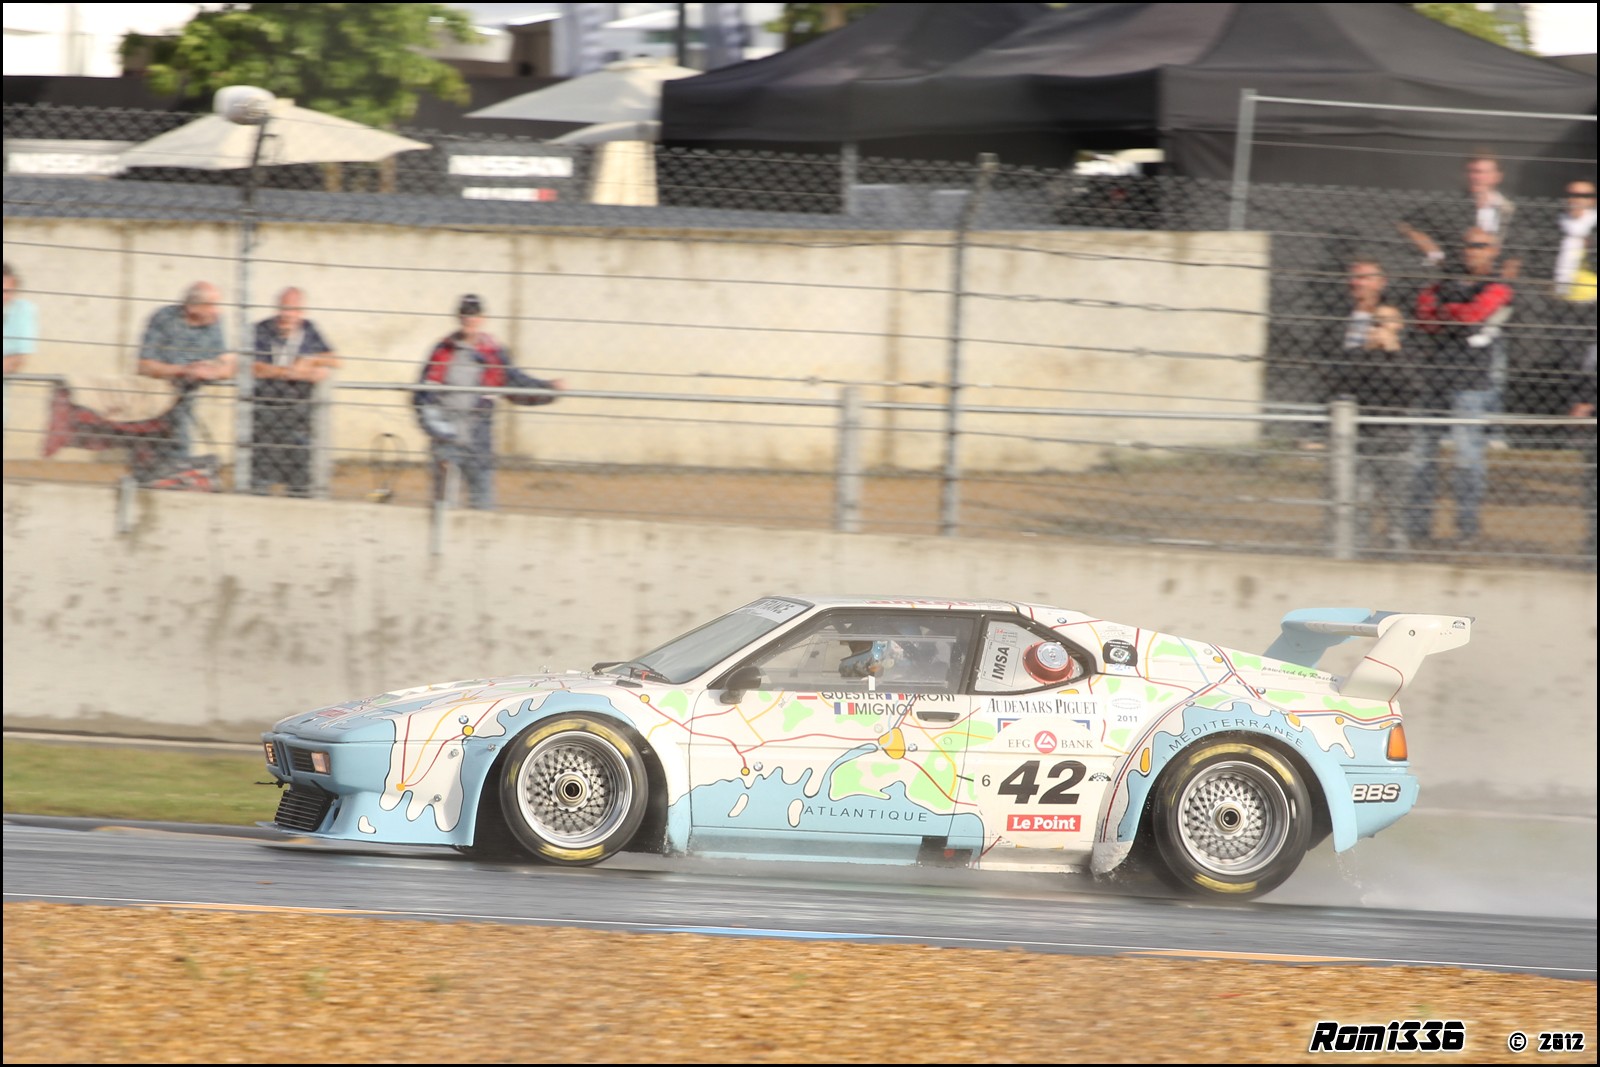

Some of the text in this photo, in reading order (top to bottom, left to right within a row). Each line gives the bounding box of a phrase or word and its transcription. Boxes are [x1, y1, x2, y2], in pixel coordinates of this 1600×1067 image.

[449, 155, 572, 178] NISSAN
[991, 646, 1010, 680] IMSA
[855, 702, 913, 717] MIGNOT
[986, 698, 1053, 714] AUDEMARS
[1055, 698, 1098, 715] PIGUET
[1117, 714, 1138, 723] 2011
[1168, 717, 1303, 752] MEDITERRANEE
[1007, 738, 1094, 749] EFG BANK
[981, 774, 991, 787] 6
[997, 760, 1087, 805] 42
[1351, 783, 1400, 803] BBS
[804, 805, 928, 822] ATLANTIQUE
[1012, 816, 1076, 830] Le Point
